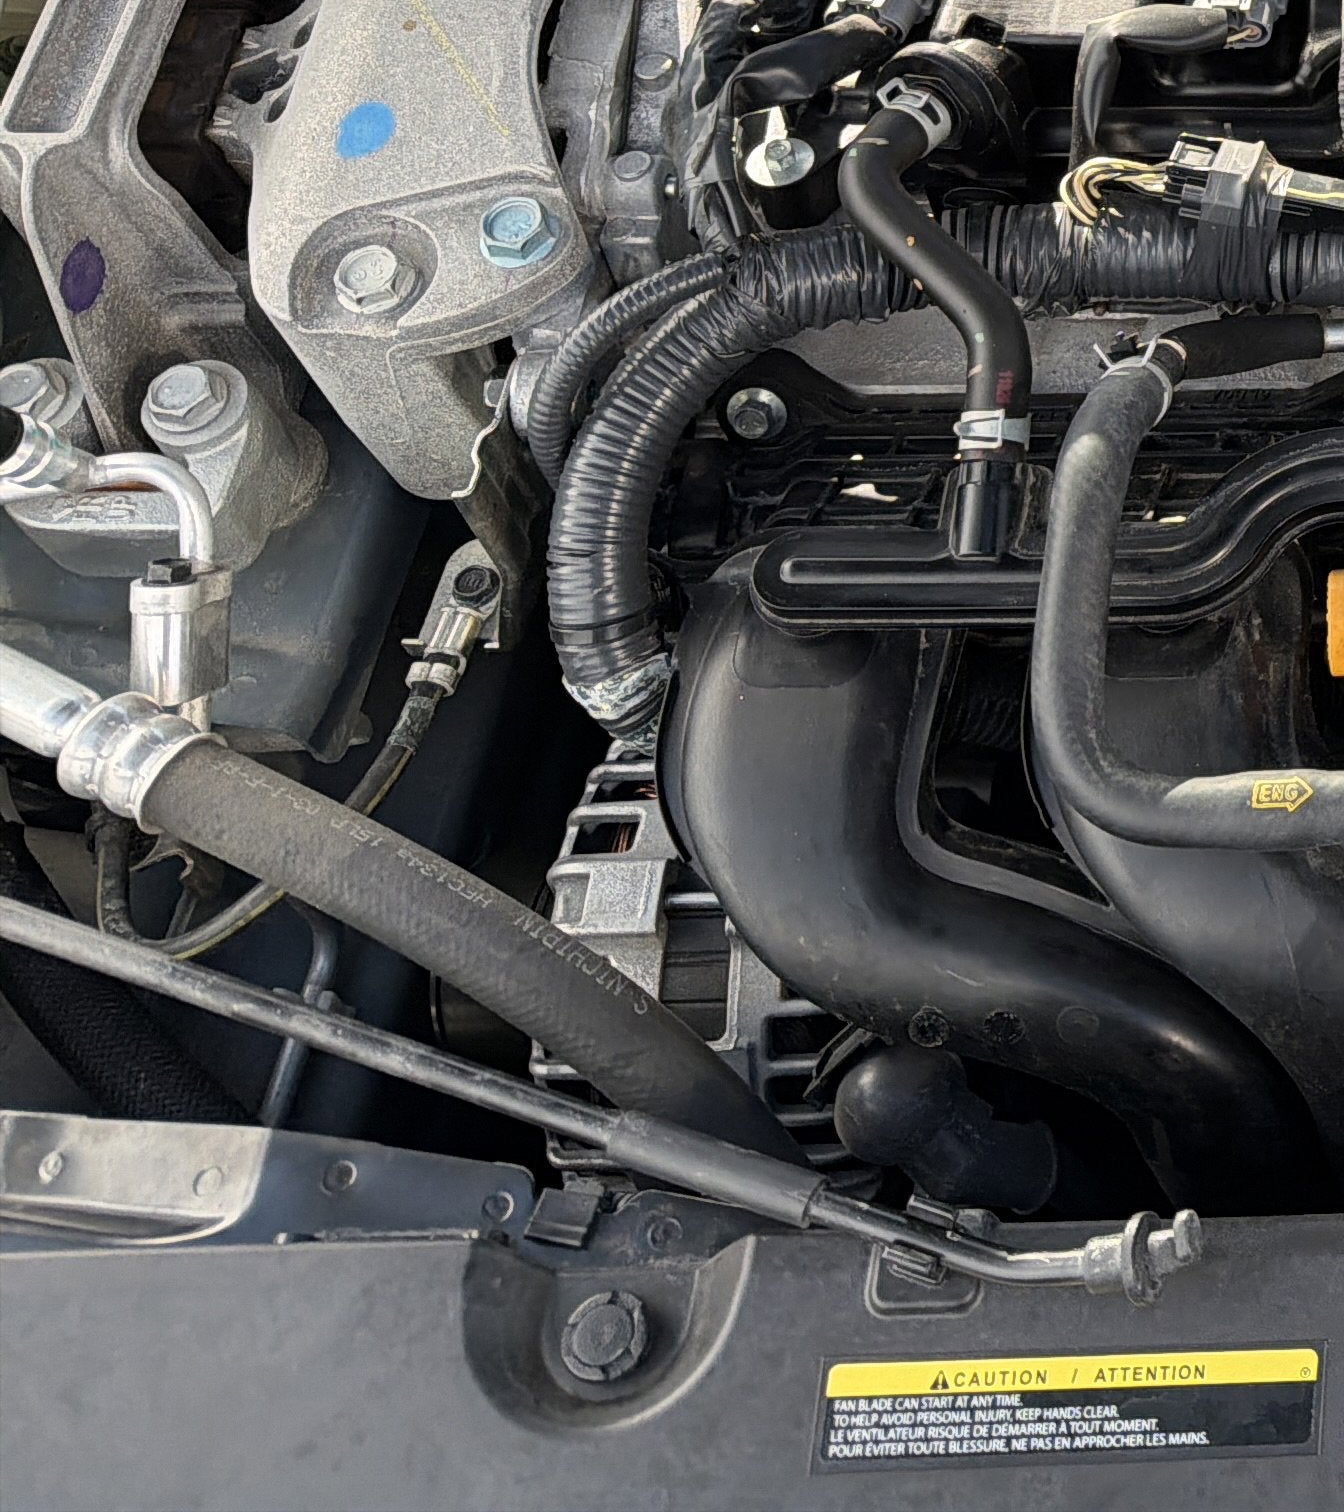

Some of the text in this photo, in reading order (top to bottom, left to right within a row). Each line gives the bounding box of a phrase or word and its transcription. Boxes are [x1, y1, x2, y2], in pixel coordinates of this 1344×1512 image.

[1258, 782, 1300, 803] ENG
[954, 1365, 1206, 1388] CAUTION / ATTENTION
[833, 1394, 1023, 1411] FAN BLADE CAN START AT ANY TIME.
[833, 1414, 849, 1427] TO
[850, 1414, 878, 1426] HELP
[880, 1412, 914, 1425] AVOID
[916, 1411, 972, 1424] PERSONAL
[975, 1409, 1013, 1423] INJURY,
[1015, 1409, 1041, 1421] KEEP
[1043, 1407, 1081, 1420] HANDS
[830, 1418, 1159, 1442] LE VENTILATEUR RISQUE DE DÉMARRER À TOUT MOMENT.
[829, 1444, 863, 1458] POUR
[865, 1442, 905, 1456] ÉVITER
[908, 1441, 945, 1455] TOUTE
[1011, 1438, 1028, 1451] NE
[1030, 1437, 1051, 1450] PAS
[1055, 1437, 1070, 1449] EN
[1073, 1433, 1144, 1449] APPROCHER
[1147, 1433, 1166, 1446] LES
[1169, 1431, 1209, 1445] MAINS.
